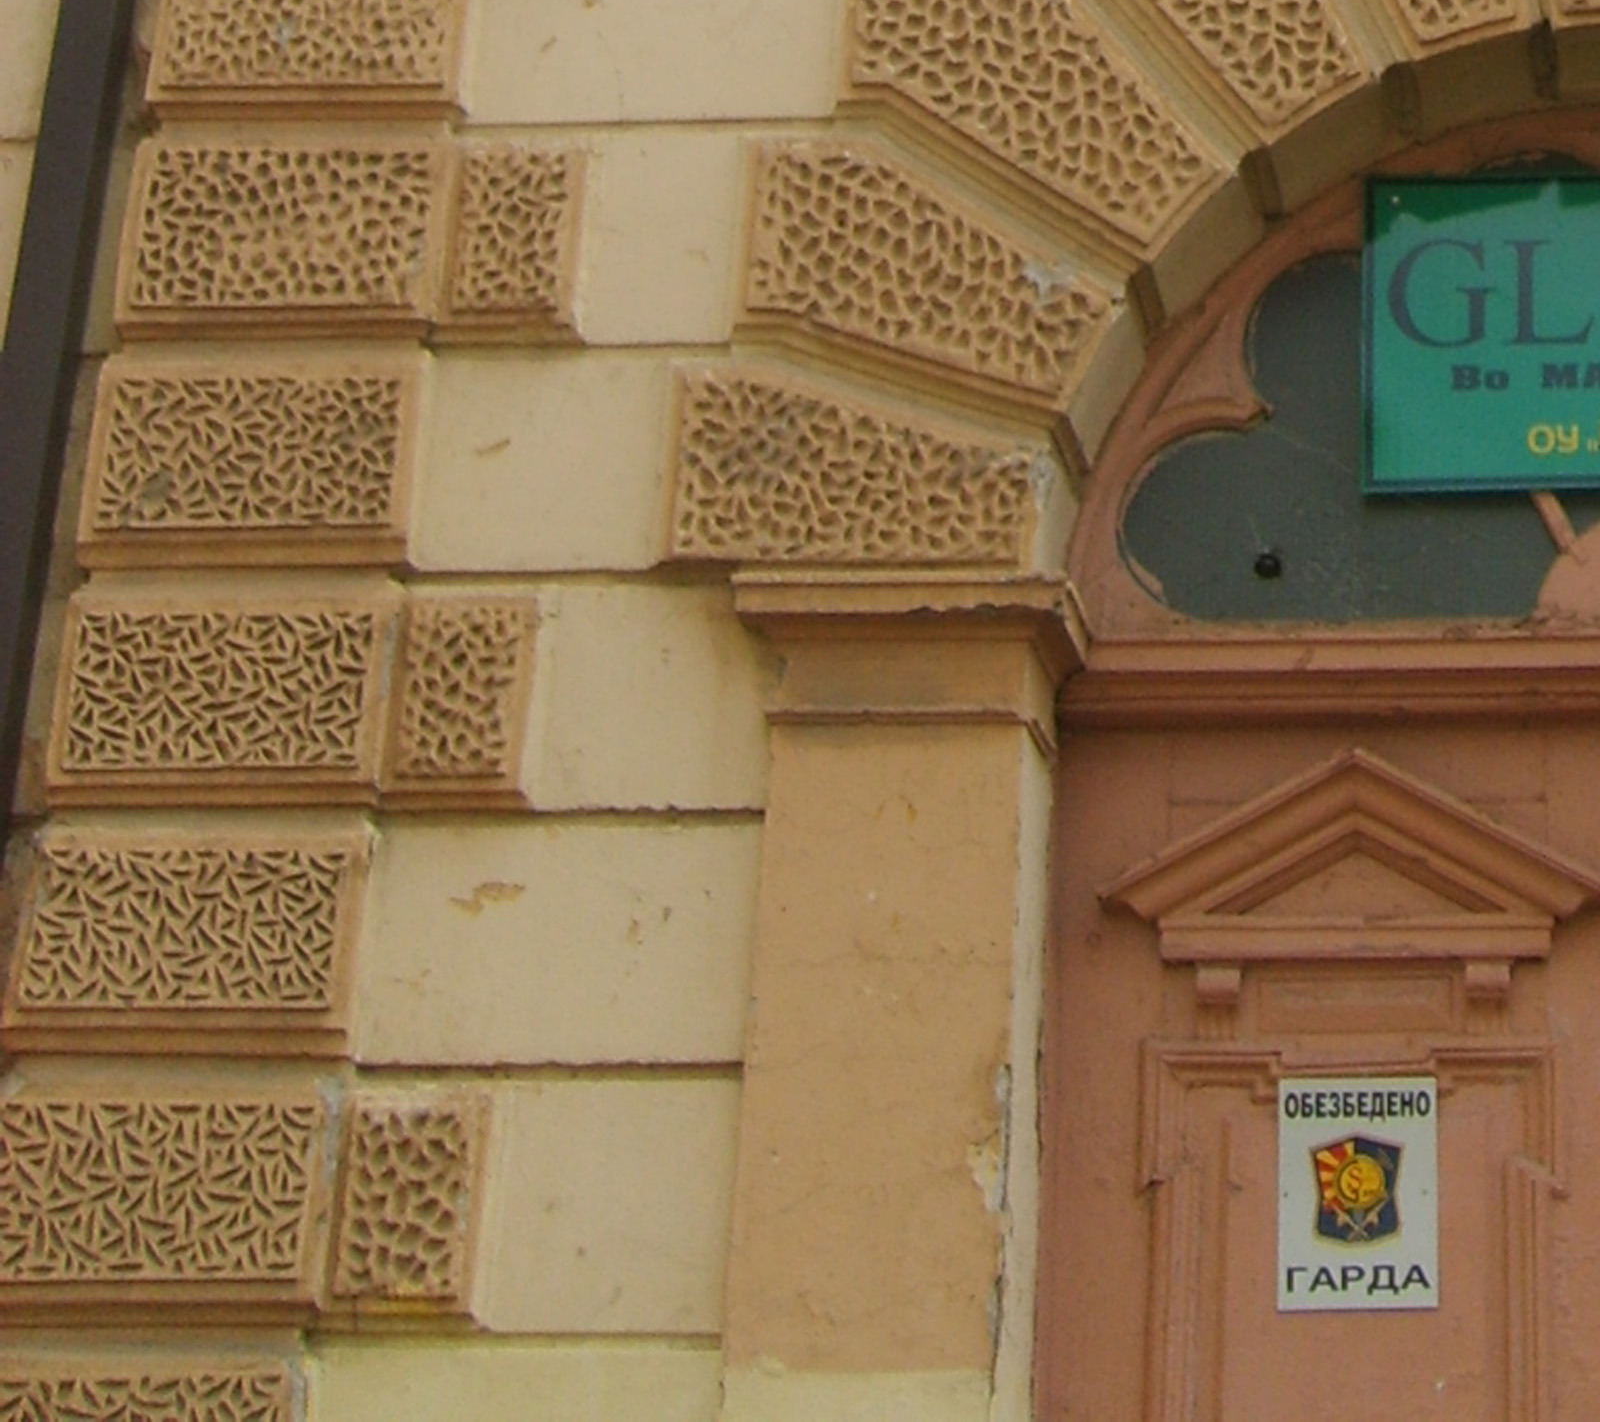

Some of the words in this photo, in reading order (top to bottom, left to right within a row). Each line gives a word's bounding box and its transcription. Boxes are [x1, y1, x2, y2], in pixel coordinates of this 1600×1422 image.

[1451, 364, 1509, 391] Во
[1527, 423, 1579, 455] ОУ
[1284, 1091, 1431, 1121] ОБЕЗБЕДЕНО
[1287, 1265, 1430, 1295] ГАРДА
